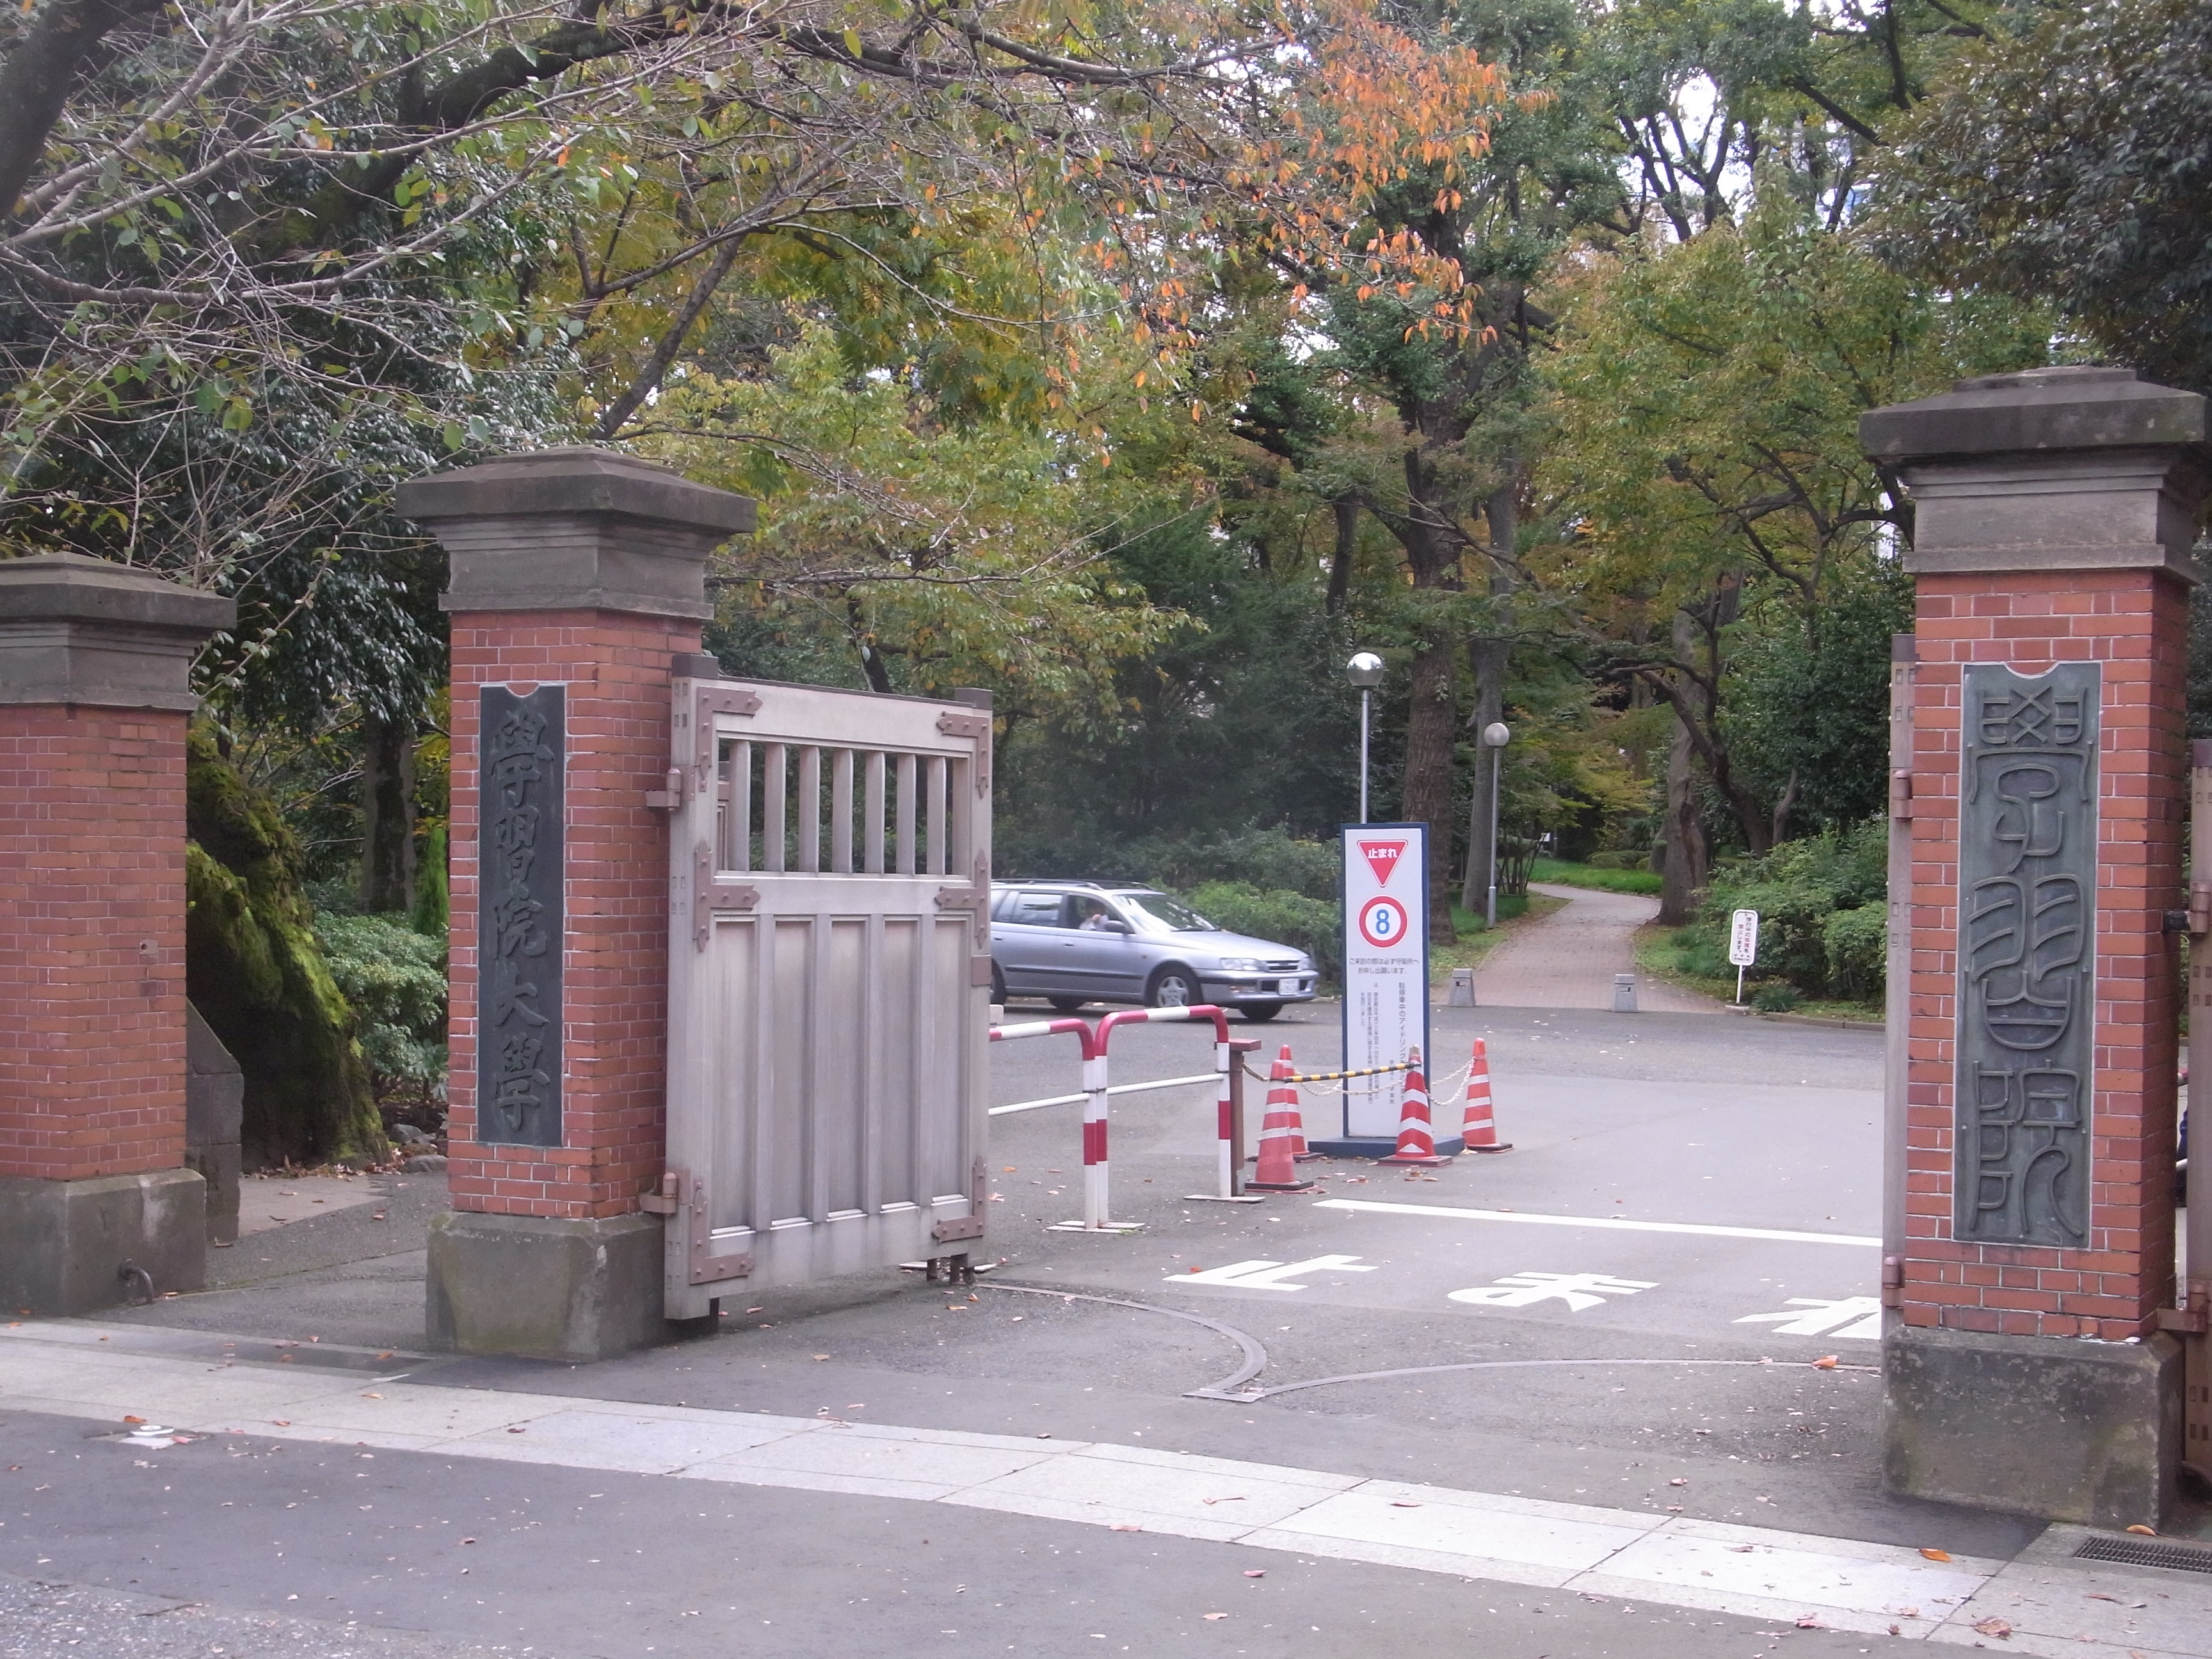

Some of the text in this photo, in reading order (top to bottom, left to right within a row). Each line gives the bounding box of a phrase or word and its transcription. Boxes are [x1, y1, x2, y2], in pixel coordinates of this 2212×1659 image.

[1368, 848, 1397, 858] 止まれ
[1376, 909, 1390, 934] 8
